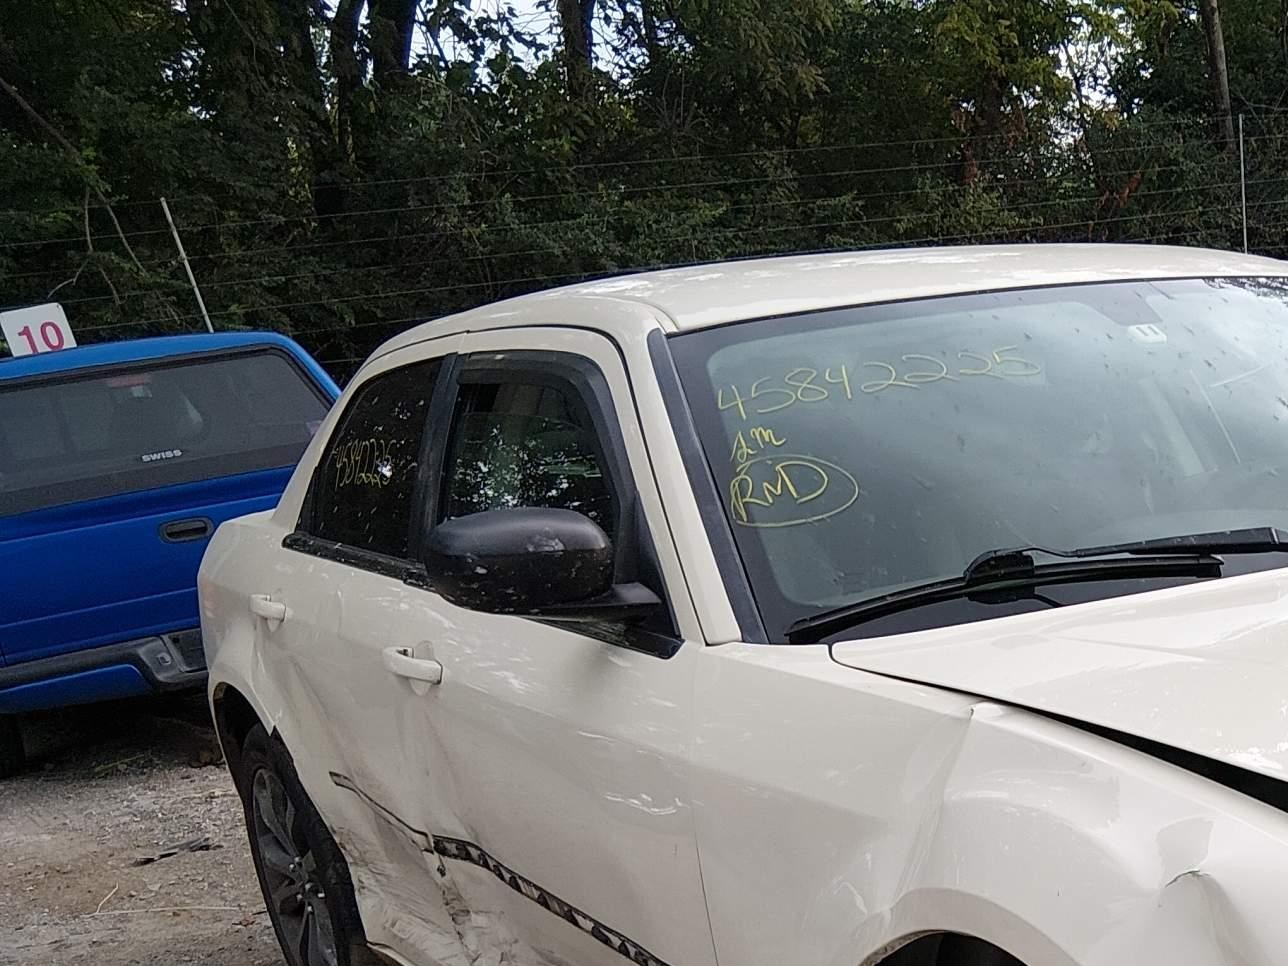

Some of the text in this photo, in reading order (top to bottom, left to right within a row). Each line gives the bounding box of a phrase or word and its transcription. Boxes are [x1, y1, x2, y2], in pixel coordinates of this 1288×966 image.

[17, 321, 65, 355] 10
[717, 345, 1041, 421] 45842225
[142, 449, 182, 461] SWISS
[730, 460, 829, 522] RMD
